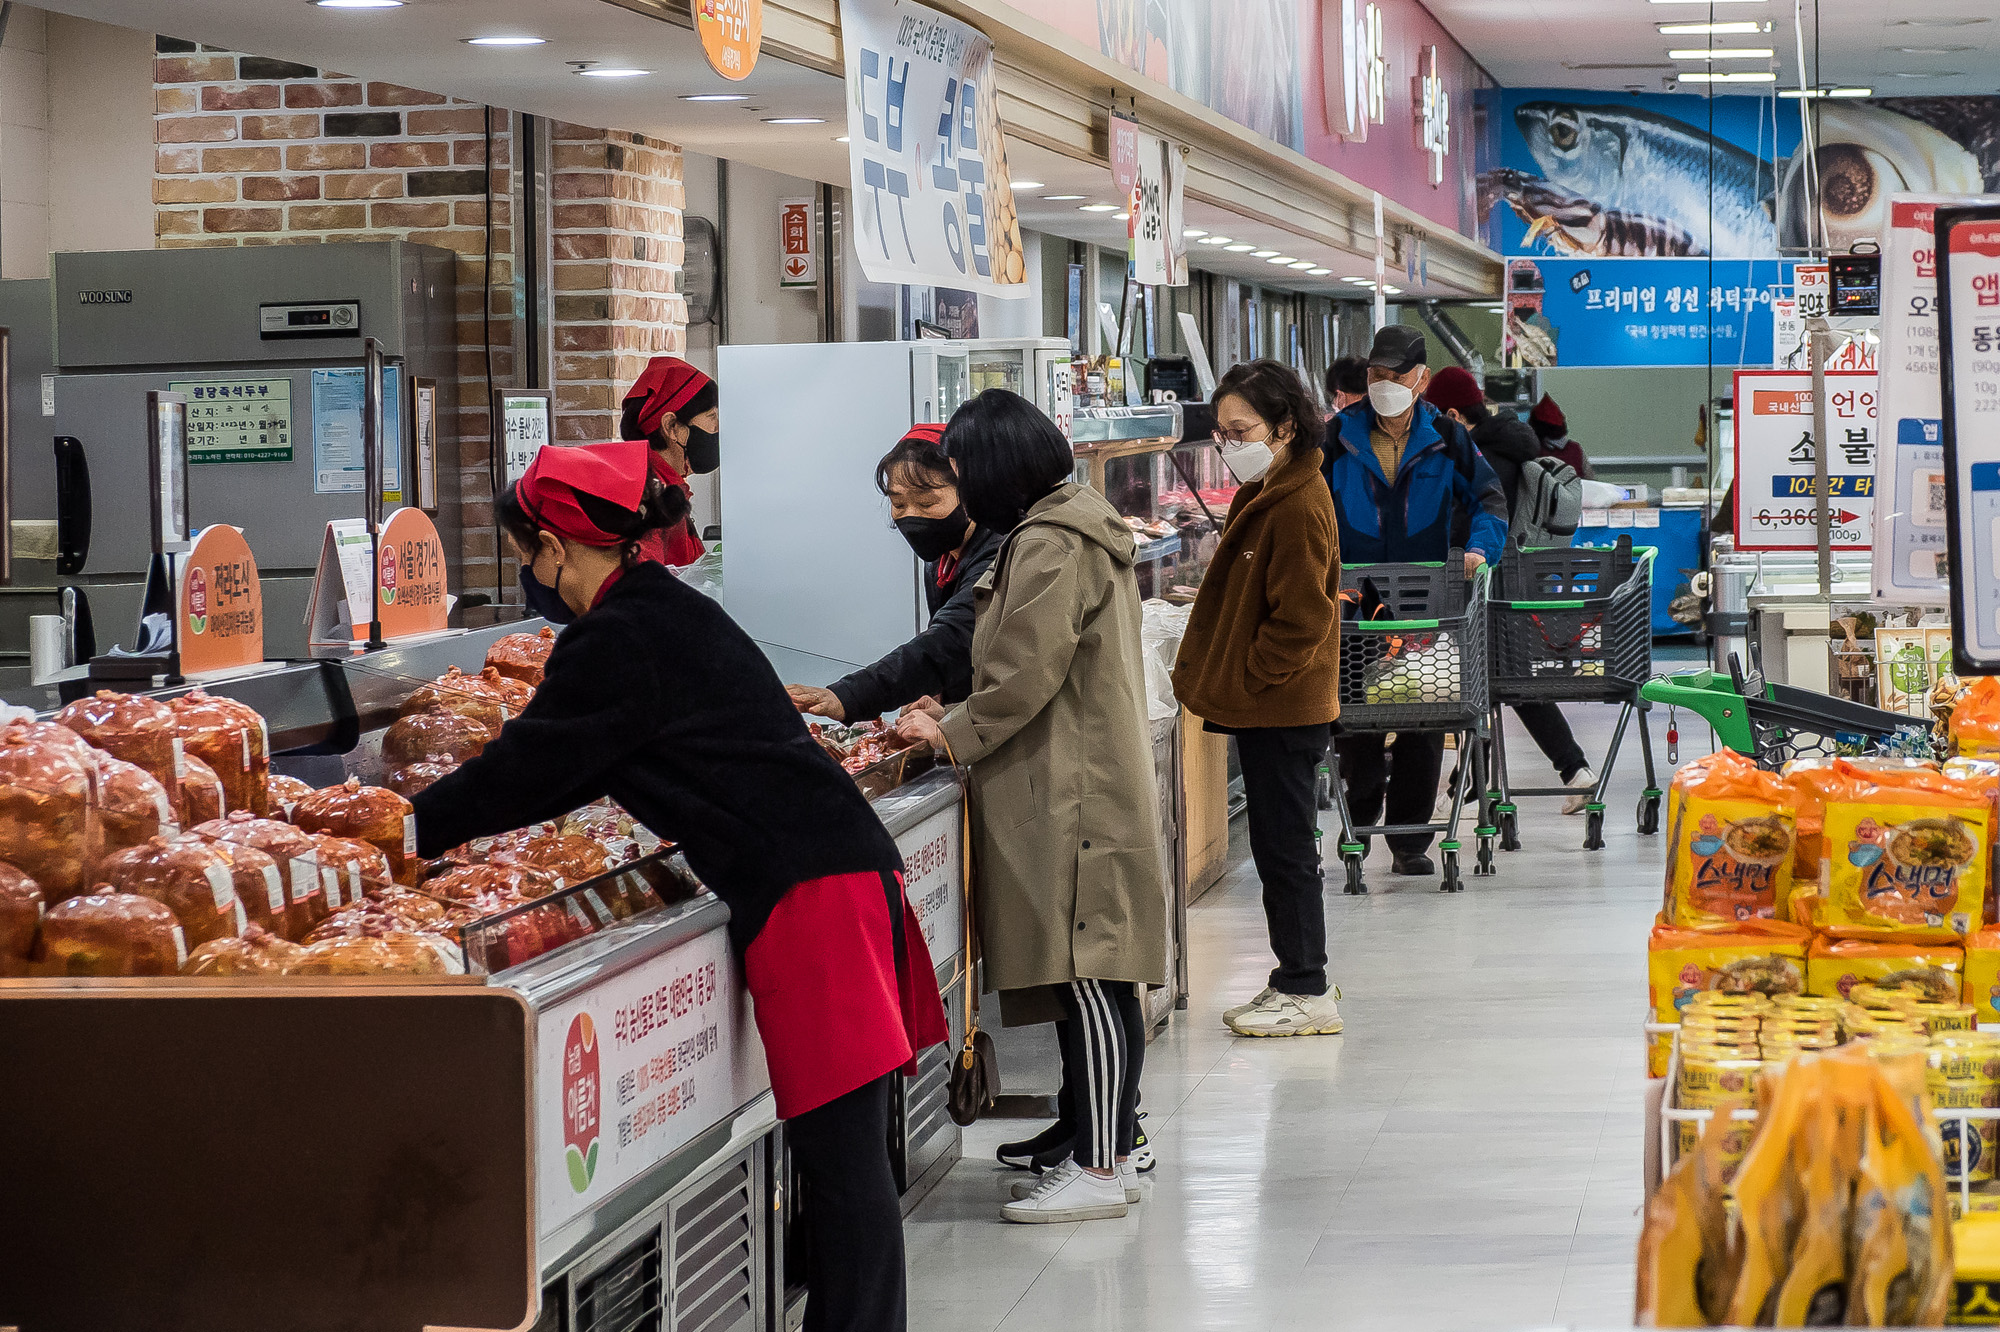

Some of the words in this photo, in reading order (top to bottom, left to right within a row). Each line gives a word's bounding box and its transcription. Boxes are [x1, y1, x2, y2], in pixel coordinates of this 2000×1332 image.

[860, 48, 916, 264] 두부
[787, 213, 805, 251] 소화기
[79, 291, 104, 304] WOO
[104, 290, 133, 303] SUNG
[1585, 286, 1656, 313] 프리미엄
[1664, 286, 1699, 313] 생선
[1972, 273, 2000, 306] 앱
[193, 385, 269, 398] 원당즉석두부
[1768, 402, 1800, 413] 국내산
[1974, 399, 2000, 412] 222
[214, 560, 250, 607] 전라도식
[1697, 858, 1772, 892] 스낵면
[1867, 862, 1953, 899] 스낵면
[615, 1003, 628, 1051] 우리
[630, 994, 654, 1044] 농산물로
[656, 985, 668, 1029] 만든
[670, 972, 693, 1020] 대한민국
[695, 966, 704, 1006] 1등
[705, 959, 716, 1002] 김치
[568, 1076, 597, 1136] 아름찬
